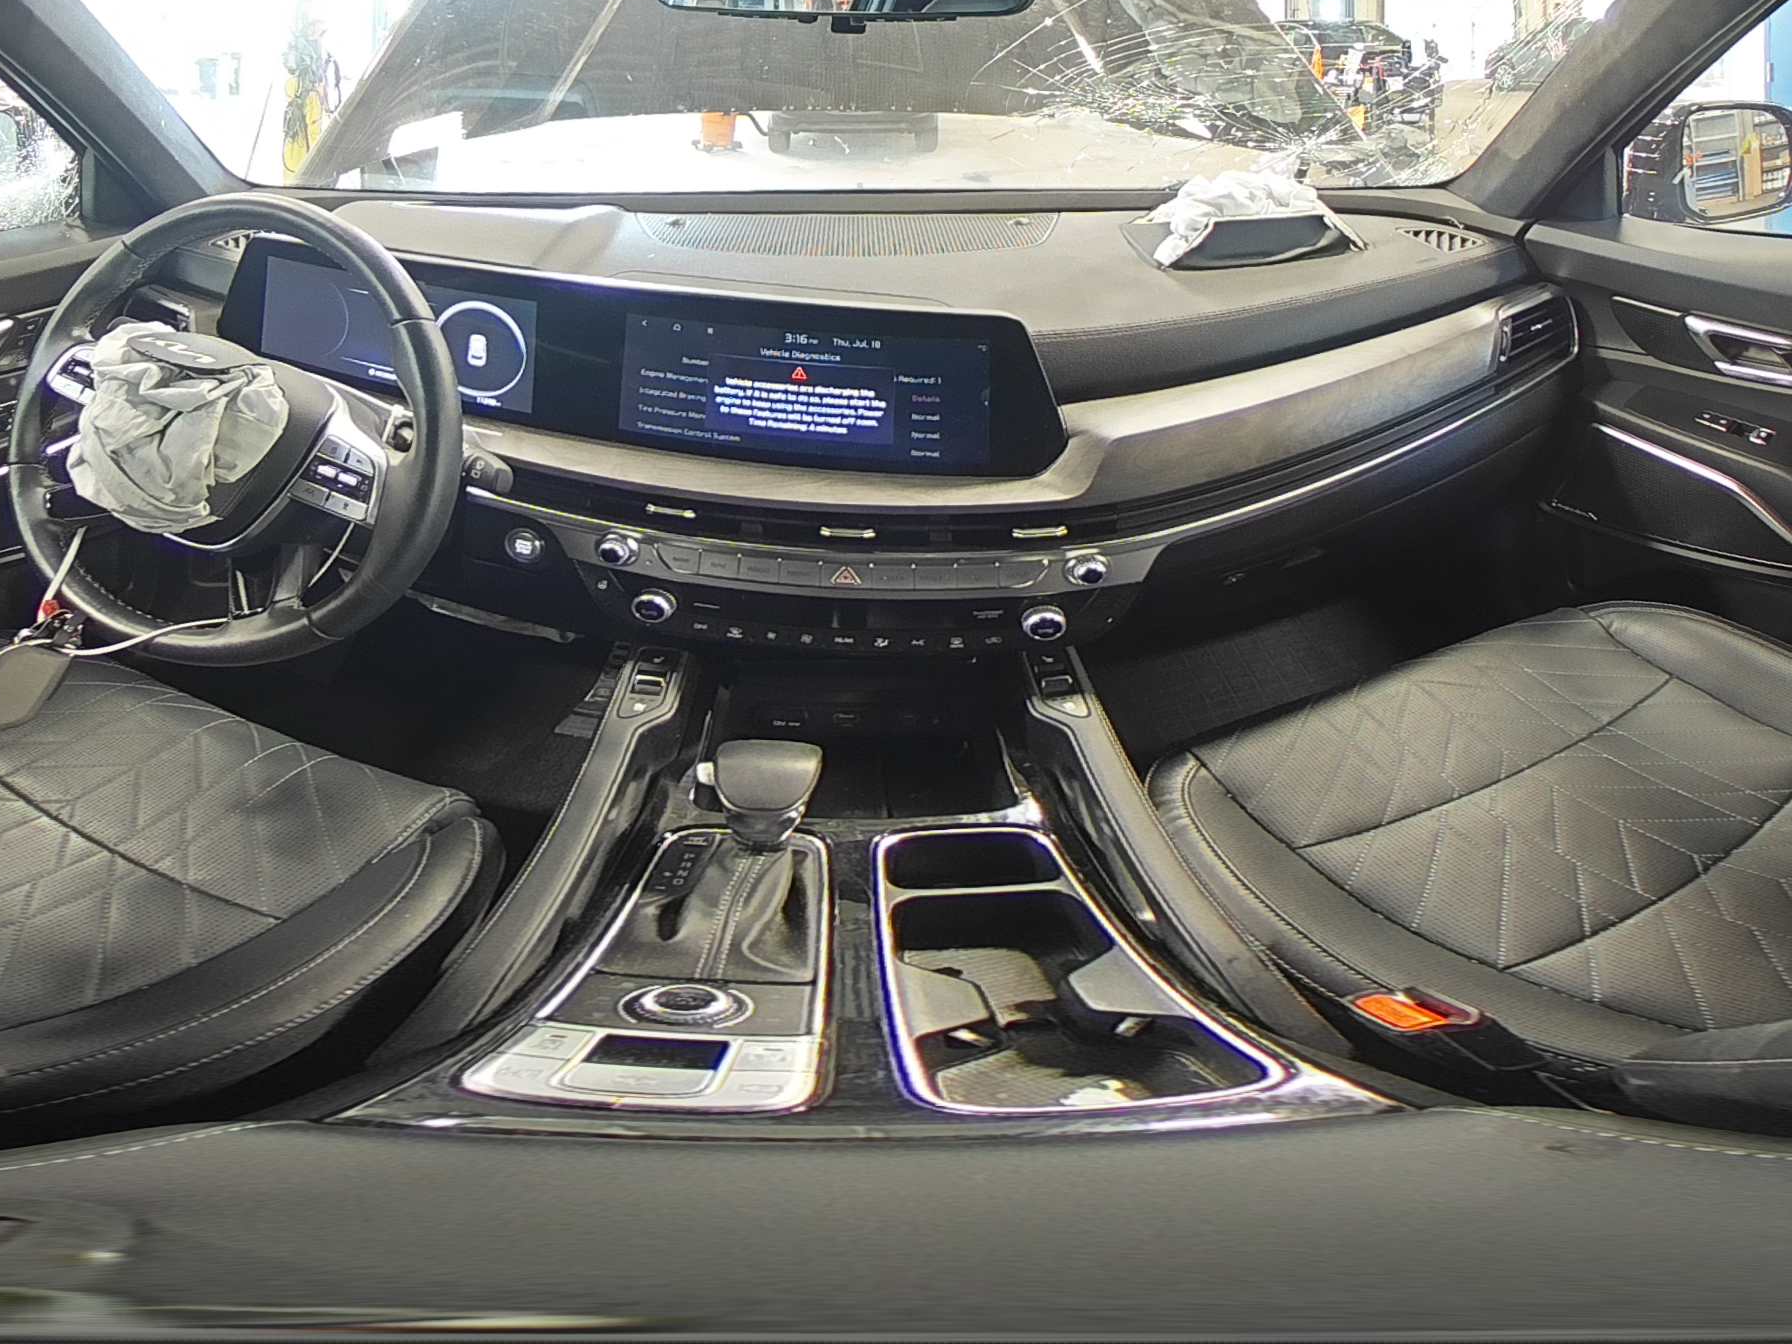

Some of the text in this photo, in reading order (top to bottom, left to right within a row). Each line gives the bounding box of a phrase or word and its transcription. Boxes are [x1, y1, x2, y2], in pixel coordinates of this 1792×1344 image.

[785, 333, 808, 344] 3:16
[760, 348, 841, 362] Vehicle Diagnostics
[860, 389, 875, 398] the
[850, 398, 870, 407] start
[872, 400, 887, 408] the
[912, 395, 940, 403] Details
[794, 403, 807, 411] the
[911, 413, 940, 422] Normal
[911, 431, 940, 440] Normal
[910, 449, 940, 458] Normal
